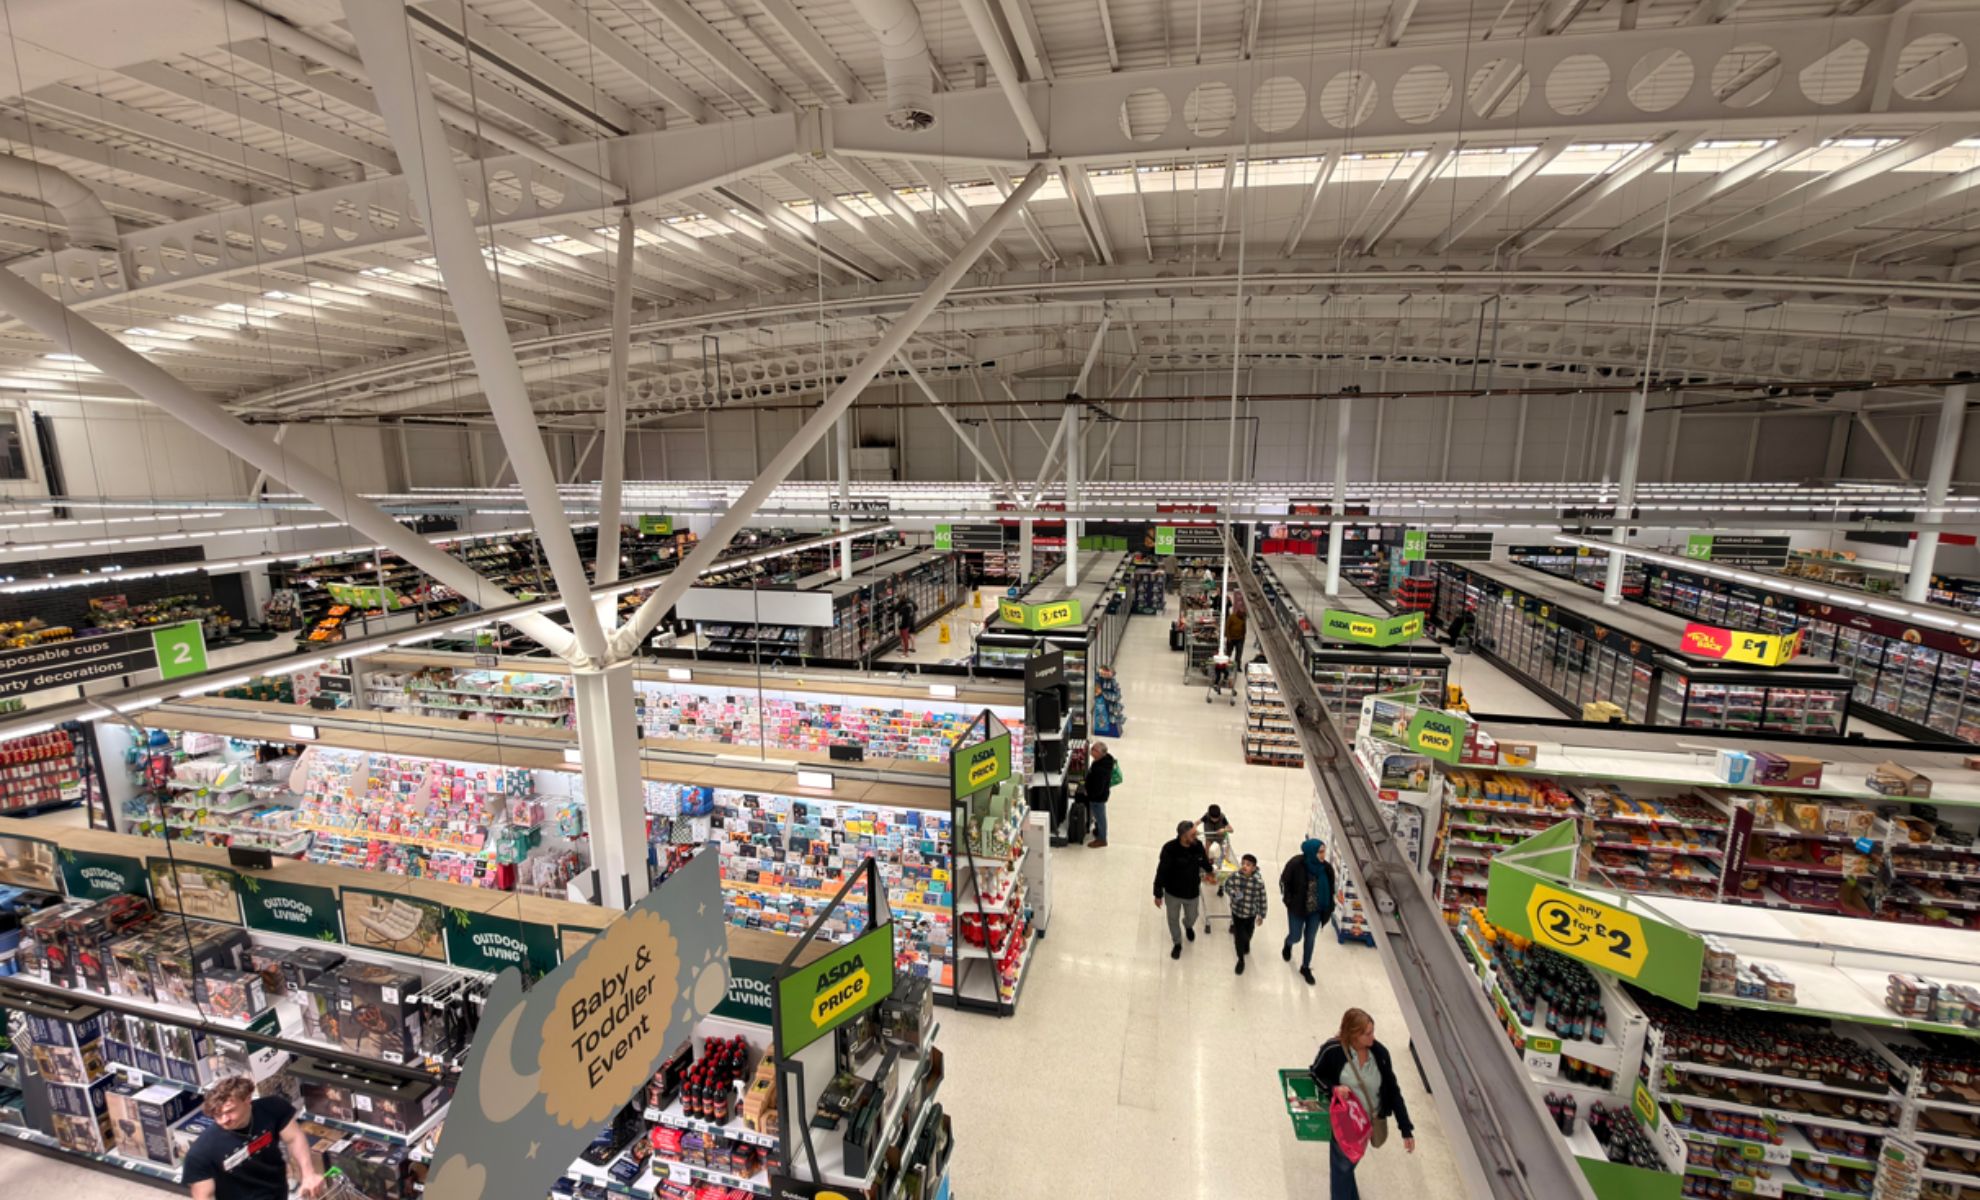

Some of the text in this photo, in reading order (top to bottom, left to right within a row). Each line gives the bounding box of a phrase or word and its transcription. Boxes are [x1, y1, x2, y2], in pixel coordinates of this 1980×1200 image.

[935, 532, 950, 542] 40
[1158, 535, 1172, 545] 39
[1688, 544, 1711, 557] 37
[1329, 619, 1350, 631] ASDA
[74, 641, 110, 656] cups
[171, 641, 193, 665] 2
[1743, 638, 1769, 659] £1
[33, 660, 125, 686] decorations
[1423, 720, 1451, 734] ASDA
[971, 747, 995, 765] ASDA
[80, 867, 125, 885] OUTDOOR
[90, 877, 121, 892] LIVING
[263, 898, 313, 917] OUTDOOR
[272, 908, 308, 924] LIVING
[1577, 903, 1602, 919] any
[1549, 908, 1632, 959] 2 for £2
[472, 932, 528, 955] OUTDOOR
[482, 945, 520, 962] LIVING
[816, 954, 864, 993] ASDA
[571, 944, 652, 1031] Baby &
[571, 974, 656, 1063] Toddler
[587, 1014, 650, 1090] Event
